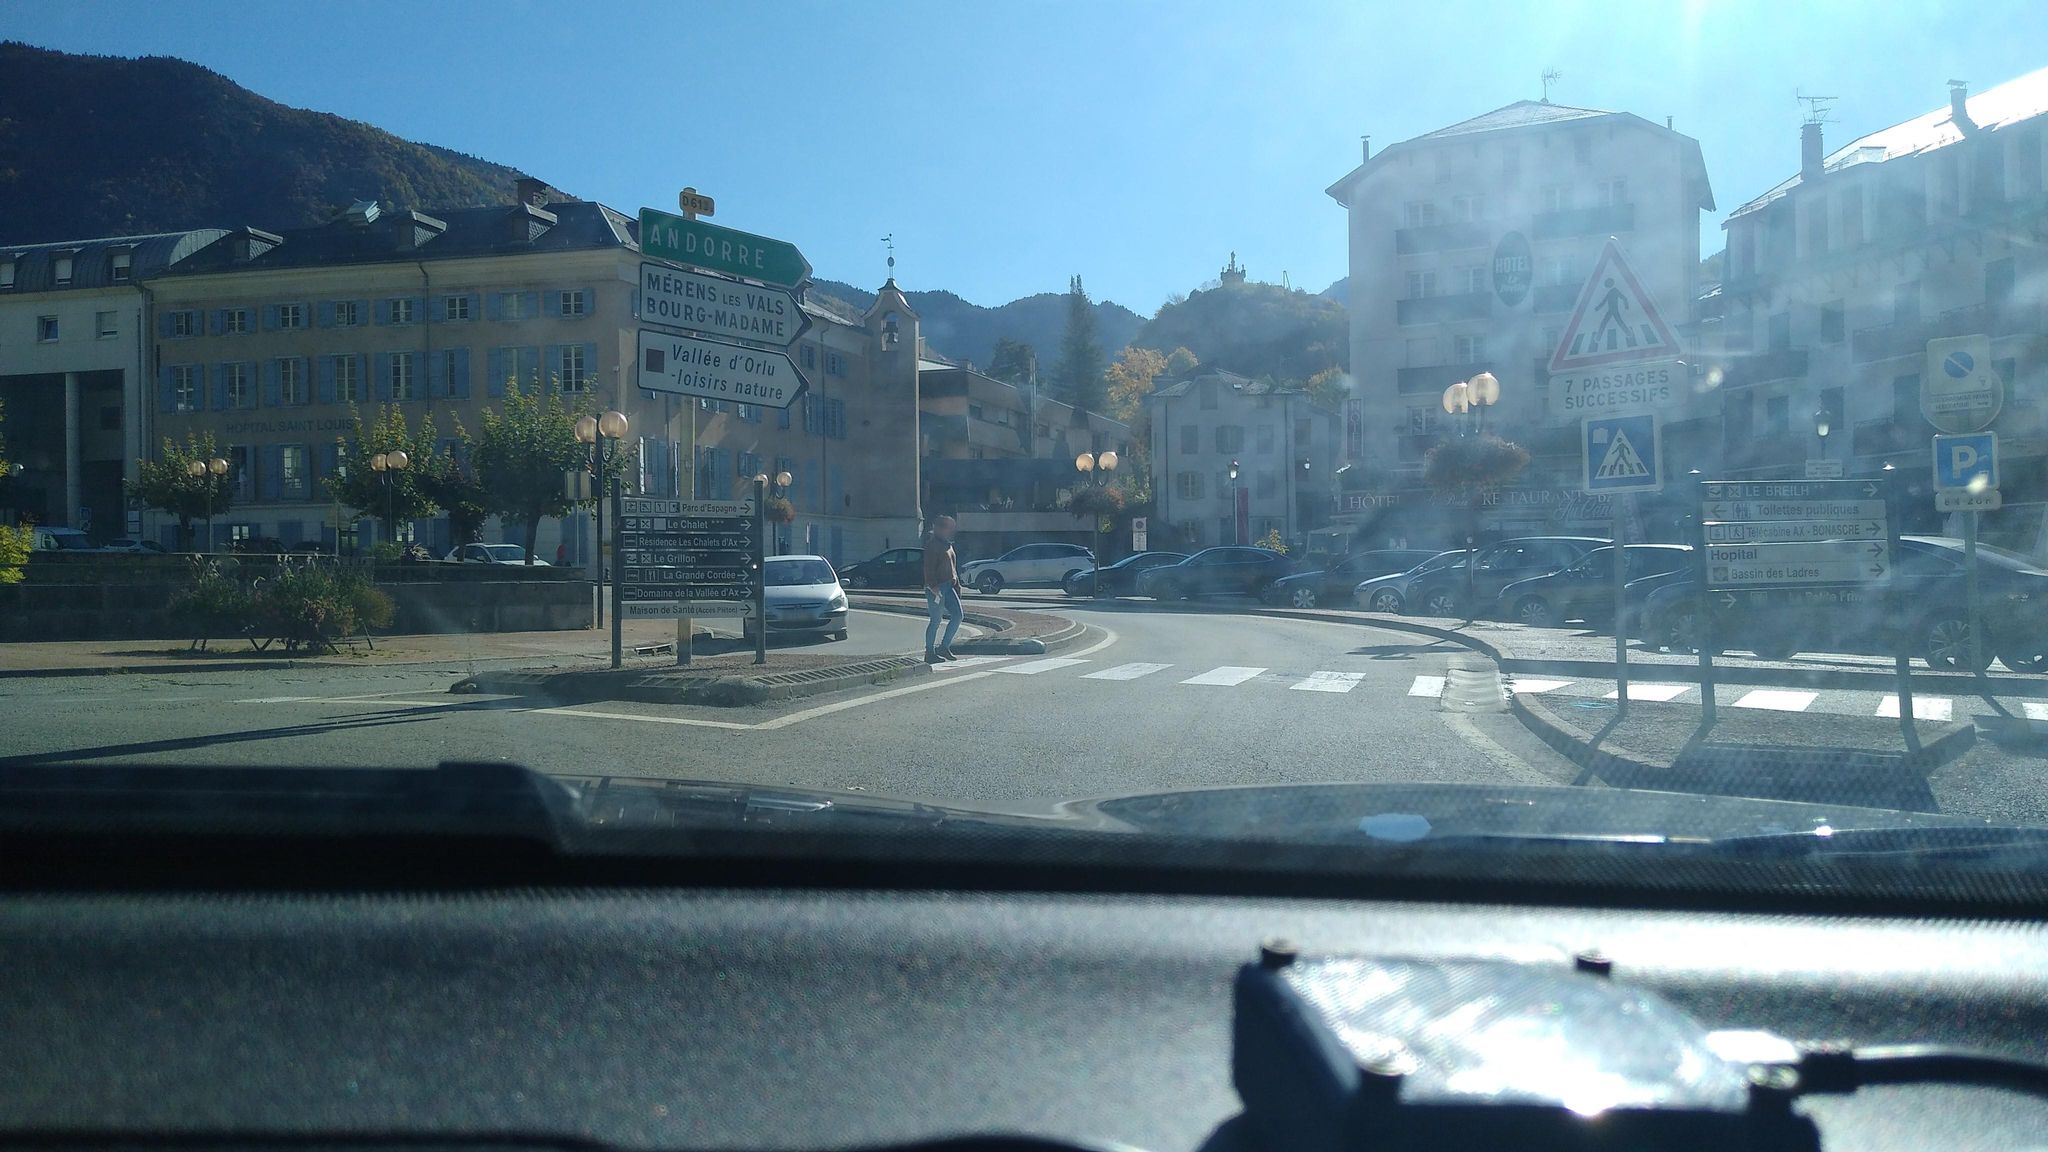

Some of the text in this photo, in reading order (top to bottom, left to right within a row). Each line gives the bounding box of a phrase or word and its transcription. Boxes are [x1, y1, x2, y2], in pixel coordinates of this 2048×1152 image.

[649, 223, 765, 270] ANDORRE
[647, 272, 785, 316] MÉRENS LES VALS
[646, 296, 785, 338] BOURG-MADAME
[672, 343, 776, 377] Vallée d'Orlu
[671, 368, 783, 400] -loisirs nature
[1565, 369, 1670, 394] 7 PASSAGES
[1565, 386, 1671, 410] SUCCESSIFS
[278, 419, 316, 432] SAINT
[317, 418, 355, 431] LOUIS
[1951, 445, 1978, 480] P
[1745, 484, 1809, 498] LE BREILH
[682, 503, 737, 514] Parc d'Espagne
[1756, 503, 1859, 517] Toilettes publiques
[667, 520, 708, 529] Le Chalet
[1793, 525, 1805, 537] AX
[1812, 524, 1860, 537] BONASCRE
[639, 537, 738, 547] Résidence Les Chalets d'Ax
[654, 554, 696, 563] Le Grillon
[663, 570, 736, 580] La Grande Cordée
[1731, 567, 1820, 579] Bassin des Ladres
[637, 588, 739, 599] Domaine de la Vallée d'Ax
[629, 605, 659, 615] Maison
[660, 606, 671, 614] de
[672, 604, 695, 615] Santé
